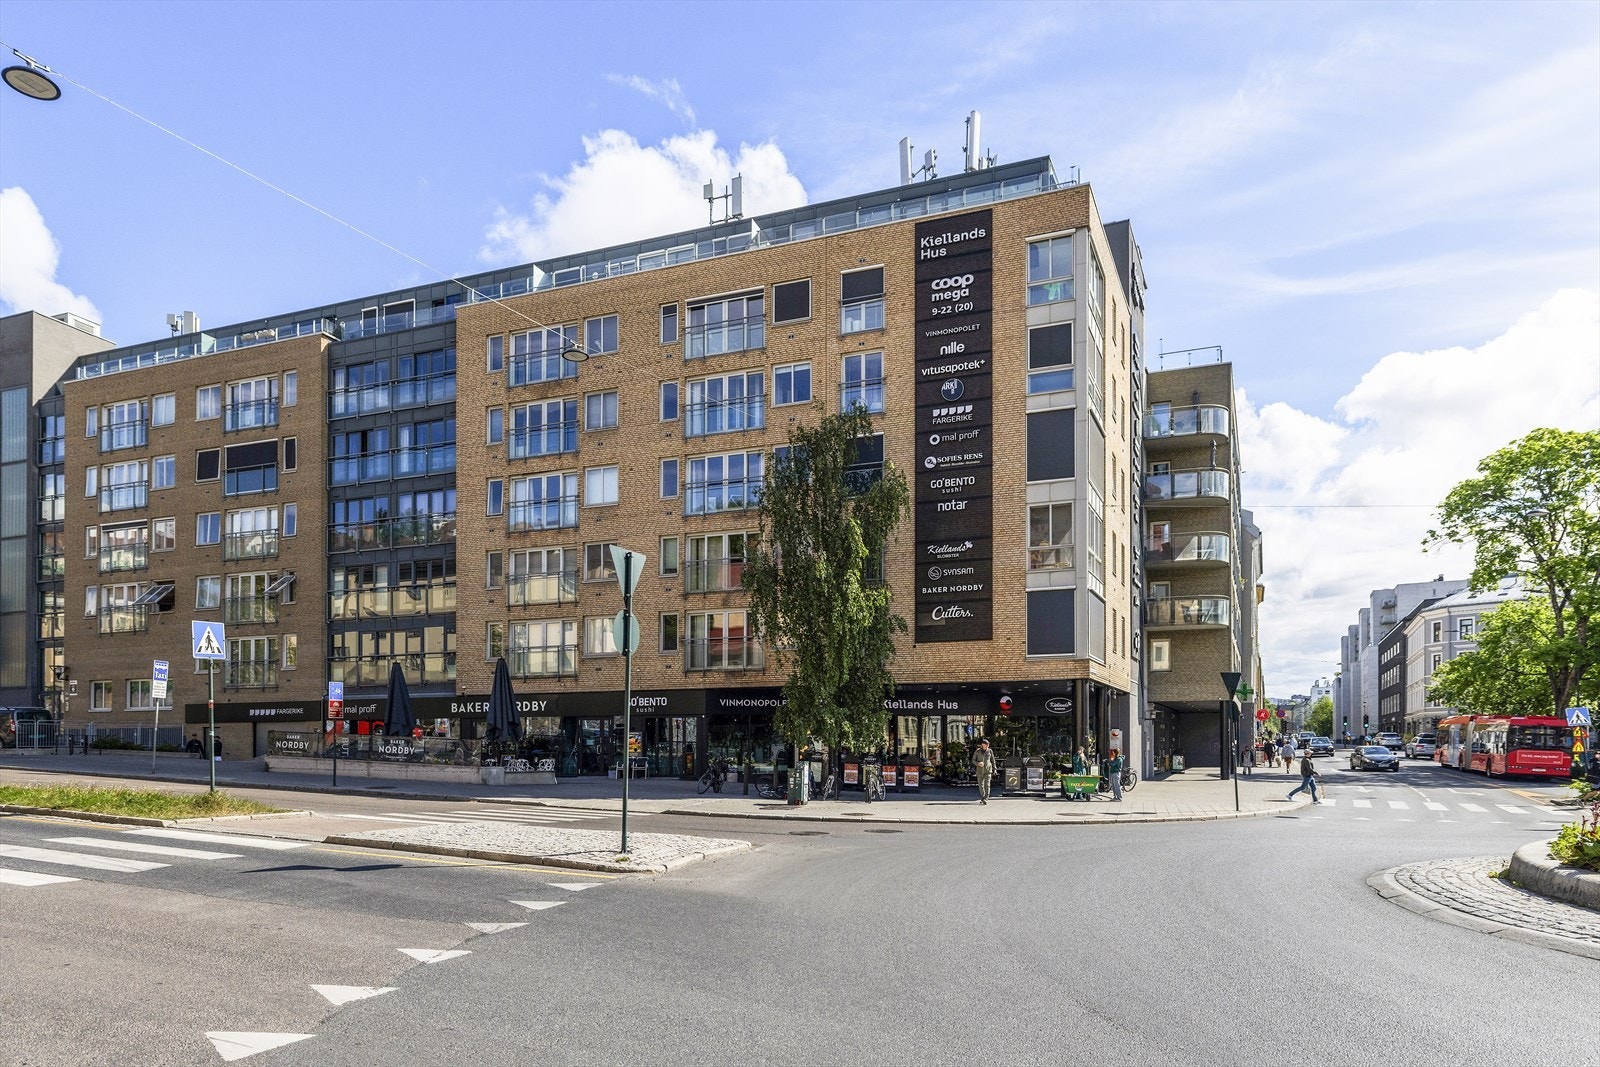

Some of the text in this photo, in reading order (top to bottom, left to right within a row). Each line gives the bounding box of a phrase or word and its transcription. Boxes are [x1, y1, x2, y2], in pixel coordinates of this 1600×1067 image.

[920, 228, 986, 248] Kiellands
[920, 247, 947, 260] Hus
[931, 274, 974, 290] coop
[931, 288, 970, 302] mega
[931, 301, 974, 316] 9-22 (20)
[925, 323, 981, 337] VINMONOPOLET
[940, 341, 965, 356] nille
[932, 413, 973, 425] FARGERIKE
[941, 428, 981, 442] mal proff
[936, 455, 962, 464] SOFIES
[963, 452, 984, 461] RENS
[930, 476, 976, 489] GO'BENTO
[937, 499, 968, 512] notar
[927, 544, 967, 555] Kiellands
[943, 567, 974, 577] SYNSAM
[922, 583, 984, 594] BAKER NORDBY
[931, 606, 974, 621] Cutters.
[451, 702, 490, 713] BAKER
[630, 696, 668, 707] O'BENTO
[719, 698, 787, 707] VINMONOPOLE
[883, 699, 959, 710] Kiellands Hus
[344, 705, 357, 713] mal
[358, 703, 377, 715] proff
[275, 740, 309, 749] NORDBY
[378, 745, 415, 755] NORDBY
